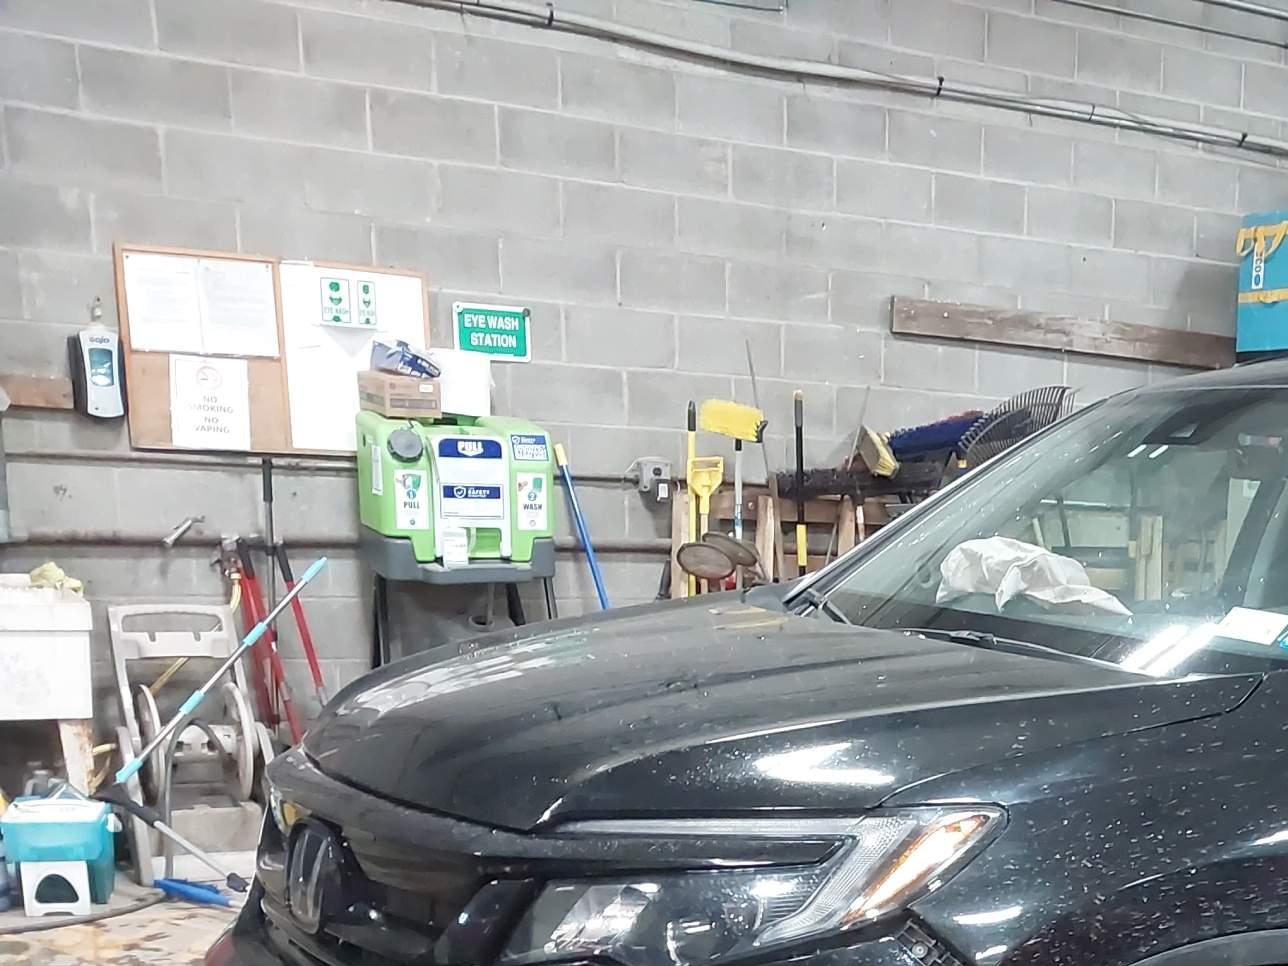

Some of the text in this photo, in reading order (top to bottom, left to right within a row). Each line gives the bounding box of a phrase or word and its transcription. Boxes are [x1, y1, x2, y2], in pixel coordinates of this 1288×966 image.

[463, 313, 519, 331] EYE WASH
[470, 332, 517, 348] STATION
[203, 395, 218, 403] NO
[204, 416, 219, 424] NO
[458, 441, 482, 451] PULL
[403, 501, 420, 509] PULL
